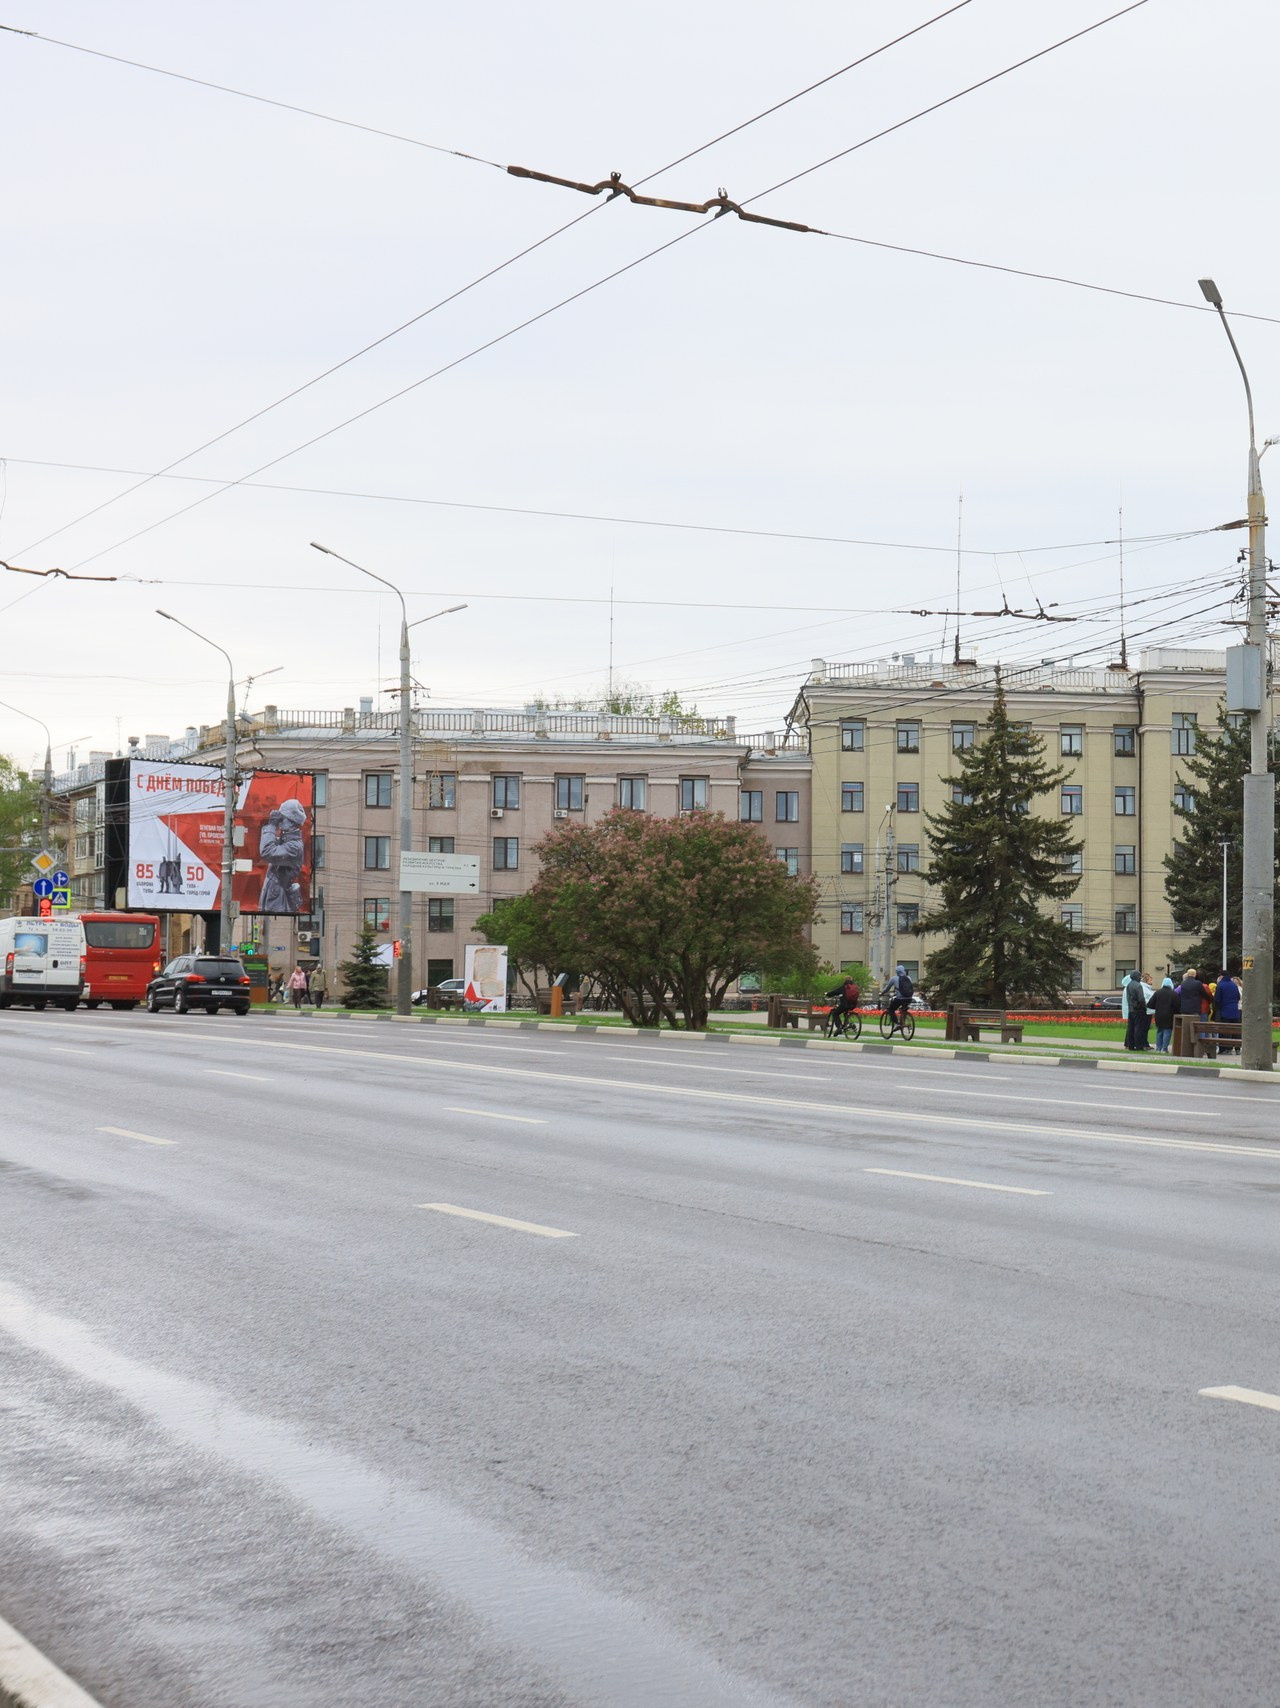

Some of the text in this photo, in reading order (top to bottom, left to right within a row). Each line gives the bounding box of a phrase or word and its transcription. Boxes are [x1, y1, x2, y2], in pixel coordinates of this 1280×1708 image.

[137, 774, 143, 788] С
[146, 773, 182, 792] ДНЁМ
[136, 863, 154, 879] 85
[186, 866, 204, 881] 50
